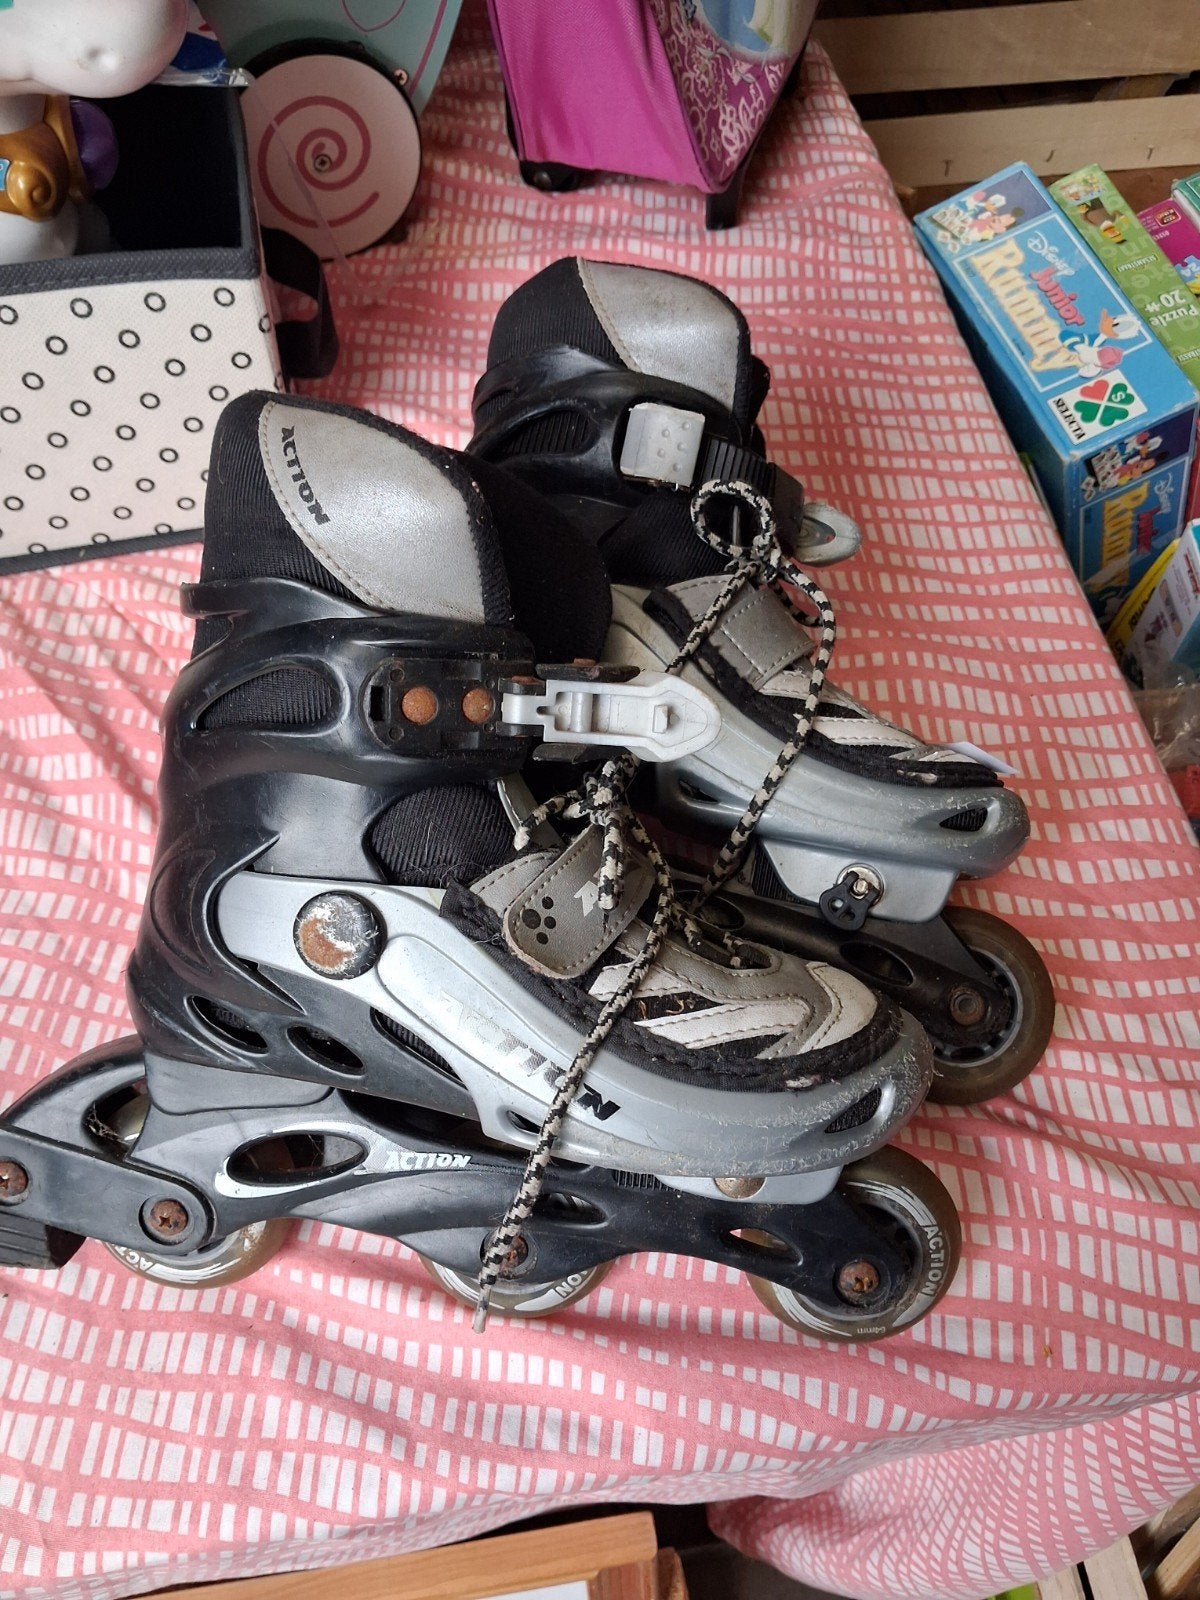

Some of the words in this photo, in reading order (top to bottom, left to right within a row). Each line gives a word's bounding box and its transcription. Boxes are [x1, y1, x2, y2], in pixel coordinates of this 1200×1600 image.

[1027, 230, 1076, 276] Disney
[969, 236, 1083, 373] Rummy
[1029, 266, 1086, 326] Junior
[1149, 304, 1199, 327] Puzzle
[1159, 289, 1186, 308] 20
[1052, 397, 1086, 441] SELECTA
[281, 425, 331, 526] ACTION
[383, 1150, 472, 1170] ACTION
[922, 1225, 945, 1296] ACTION
[857, 1325, 886, 1335] 64mm
